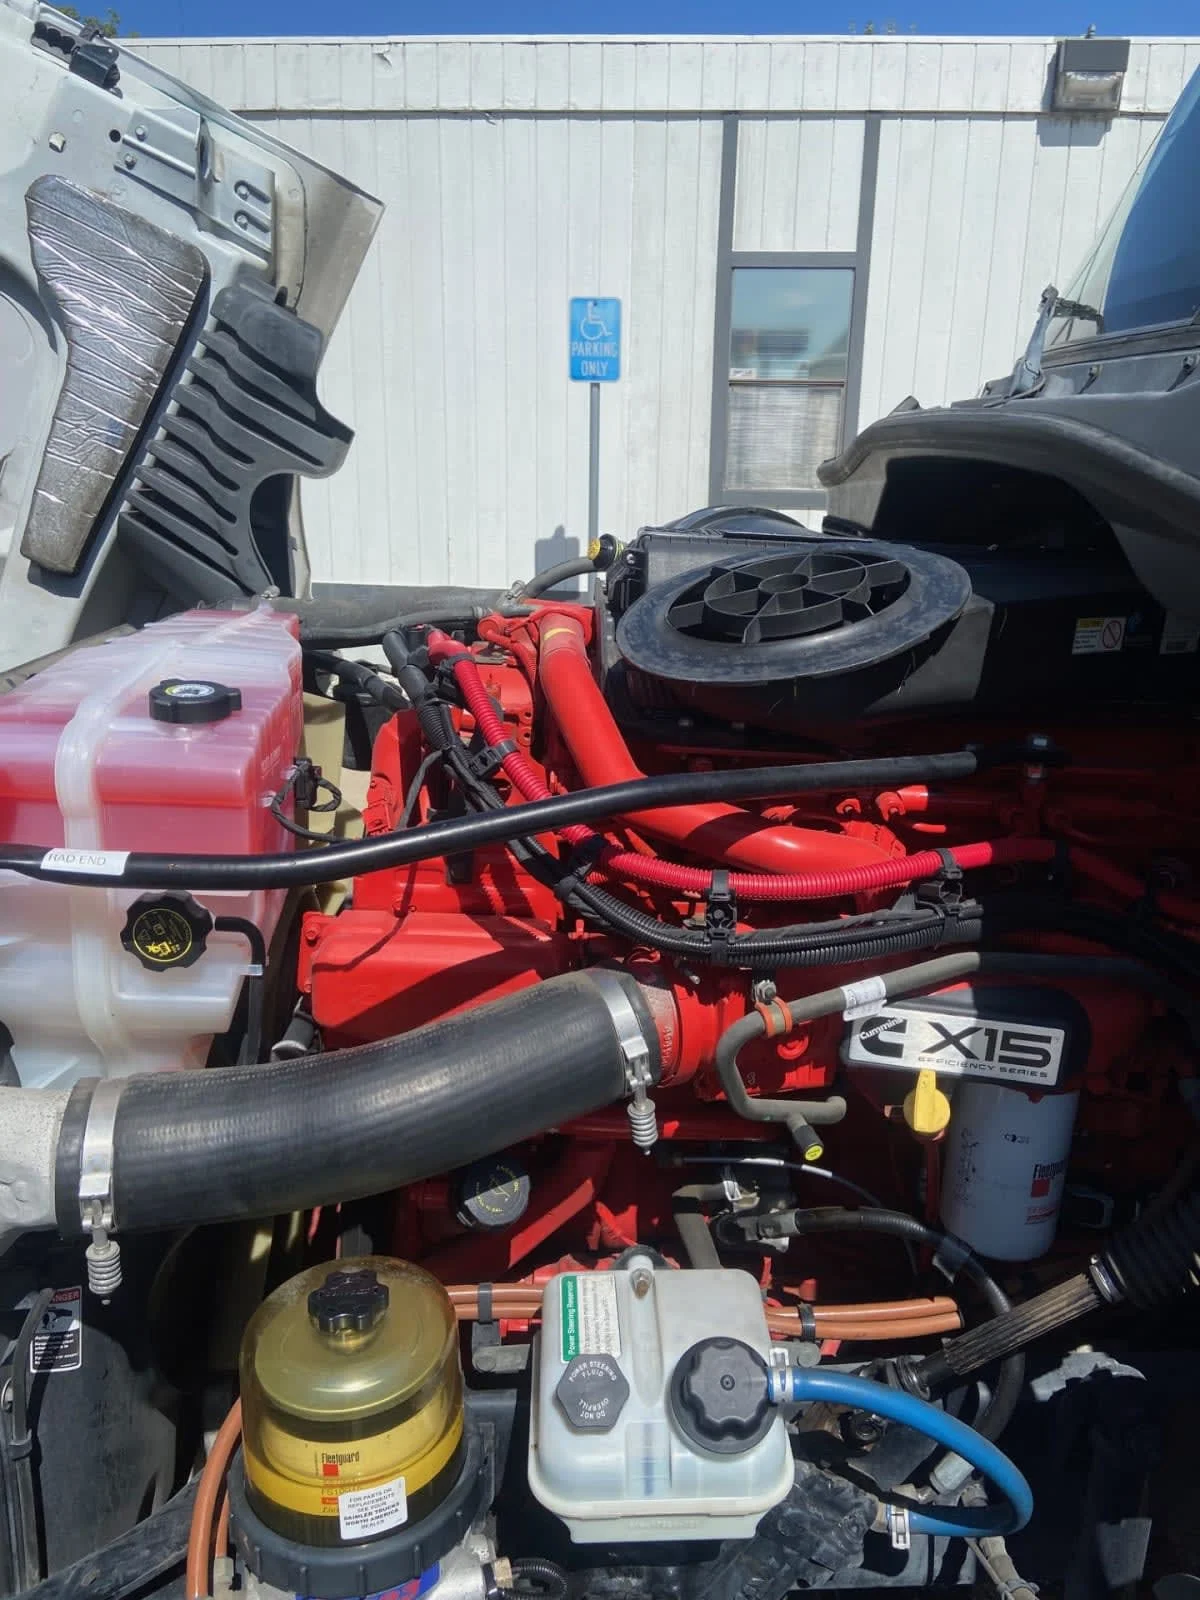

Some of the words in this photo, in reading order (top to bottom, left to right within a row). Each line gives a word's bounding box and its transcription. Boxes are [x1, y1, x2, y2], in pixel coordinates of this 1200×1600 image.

[571, 341, 618, 357] PARKING
[580, 360, 609, 376] ONLY
[79, 855, 107, 866] END
[860, 1016, 904, 1041] Cummins
[921, 1021, 1052, 1069] X15
[917, 1056, 996, 1071] EFFICIENCY
[999, 1066, 1049, 1079] SERIES
[53, 1290, 80, 1302] NGER
[566, 1280, 575, 1308] Reservoir
[567, 1308, 576, 1334] Steering
[567, 1335, 576, 1355] Power
[568, 1362, 588, 1383] POWER
[589, 1361, 617, 1381] STEERING
[581, 1368, 604, 1378] FLUID
[578, 1397, 609, 1411] OVERFILL
[580, 1411, 594, 1420] NOT
[321, 1451, 360, 1466] Fleetguard
[347, 1492, 395, 1508] REPLACEMENTS
[363, 1491, 382, 1501] PARTS
[343, 1511, 374, 1521] DAIMLER
[374, 1502, 400, 1514] TRUCKS
[345, 1517, 369, 1526] NORTH
[370, 1508, 399, 1521] AMERICA
